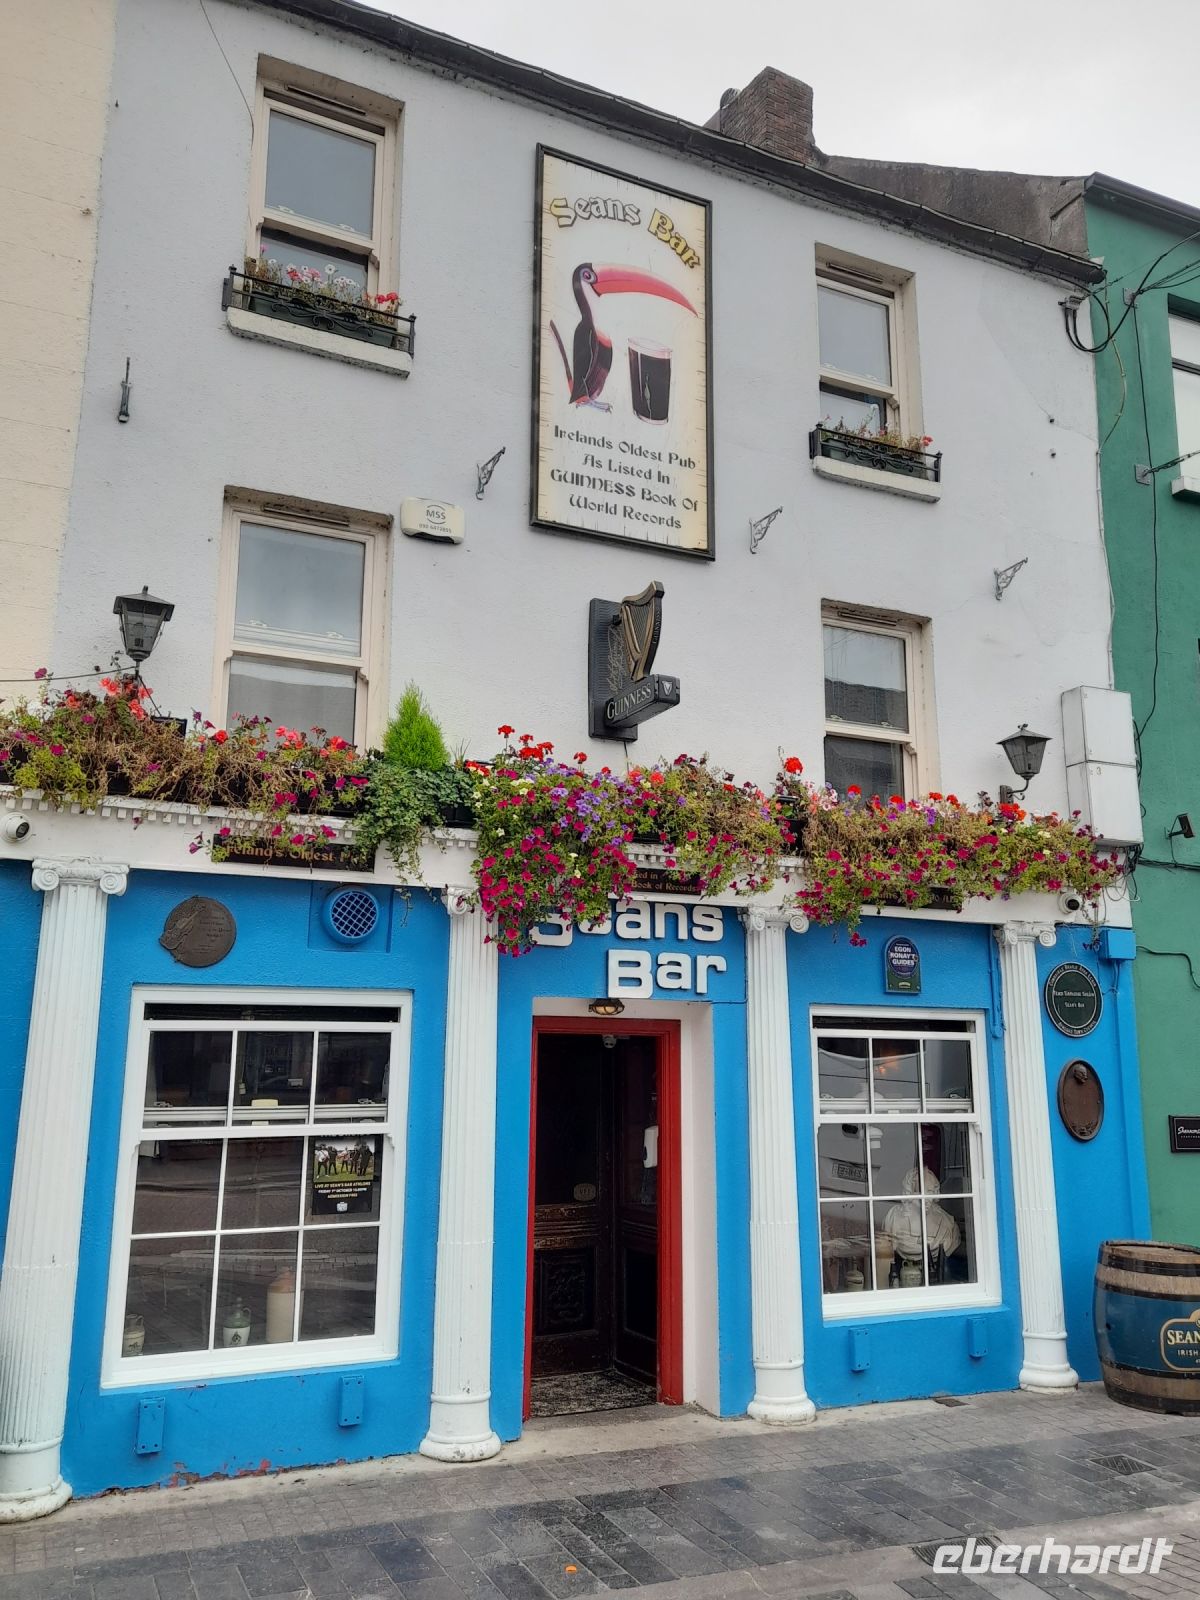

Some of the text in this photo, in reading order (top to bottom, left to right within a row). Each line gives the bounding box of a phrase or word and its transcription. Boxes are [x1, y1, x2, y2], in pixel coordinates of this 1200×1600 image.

[550, 196, 701, 269] Seans Bar
[554, 425, 696, 470] Irelands Oldest Pub
[582, 453, 671, 485] As Listed In
[550, 468, 699, 512] GUINNESS Book Of
[426, 509, 446, 520] MSS
[569, 493, 682, 529] World Records
[606, 682, 652, 720] GUINNESS
[608, 949, 727, 999] Bar
